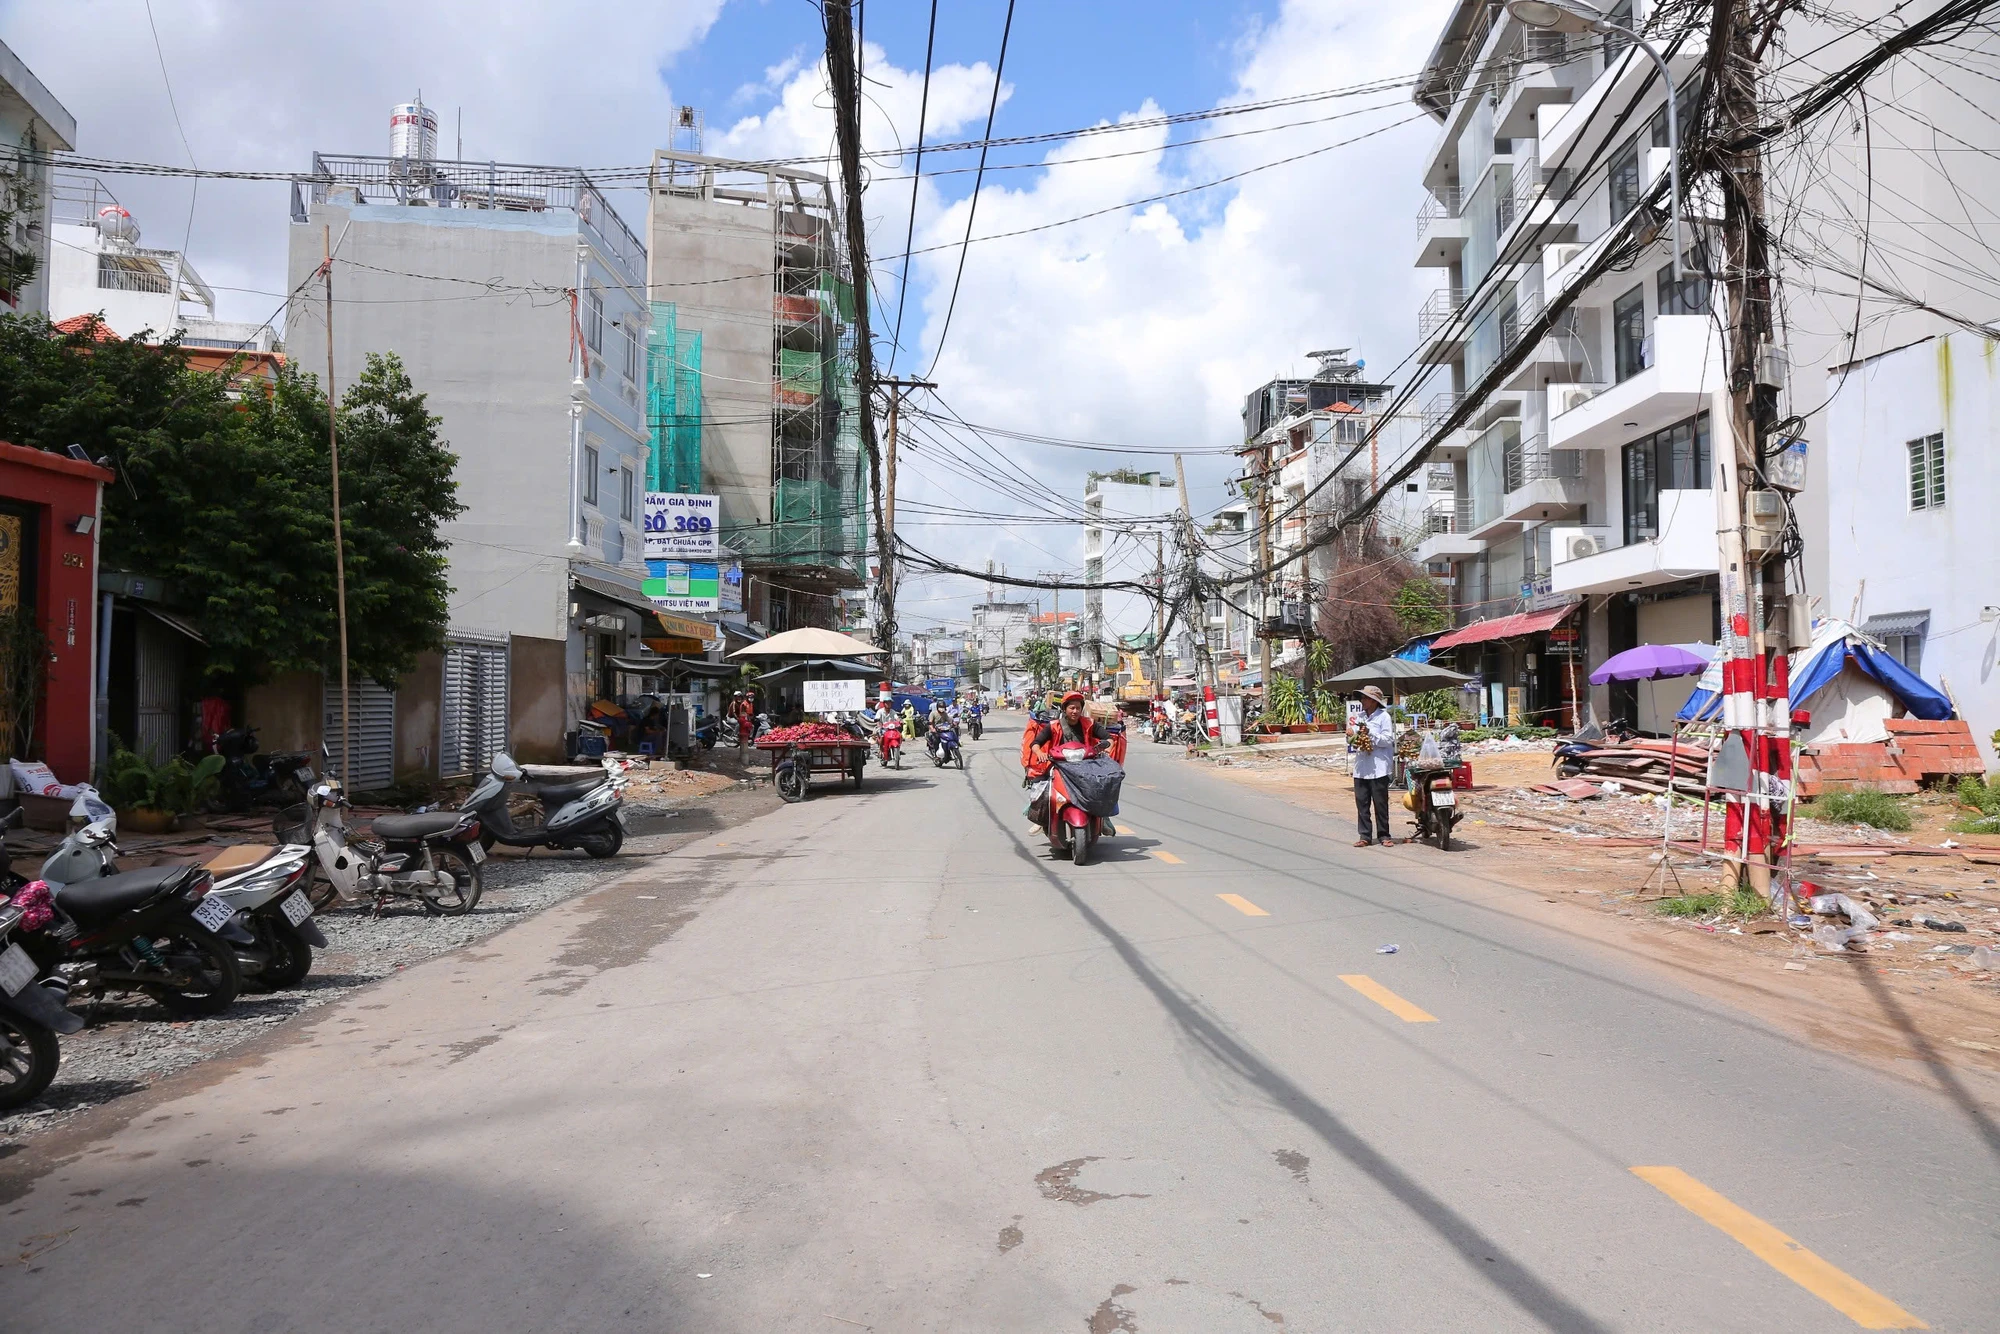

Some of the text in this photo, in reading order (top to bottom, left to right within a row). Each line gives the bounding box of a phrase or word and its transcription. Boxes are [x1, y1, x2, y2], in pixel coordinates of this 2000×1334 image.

[669, 498, 685, 507] GIA
[688, 499, 712, 509] ĐỊNH
[674, 515, 712, 532] 369
[679, 599, 693, 607] VIỆT
[1350, 704, 1364, 713] PH
[197, 897, 220, 919] 59-S3
[284, 894, 303, 913] 59-S3
[206, 904, 233, 930] 374.69
